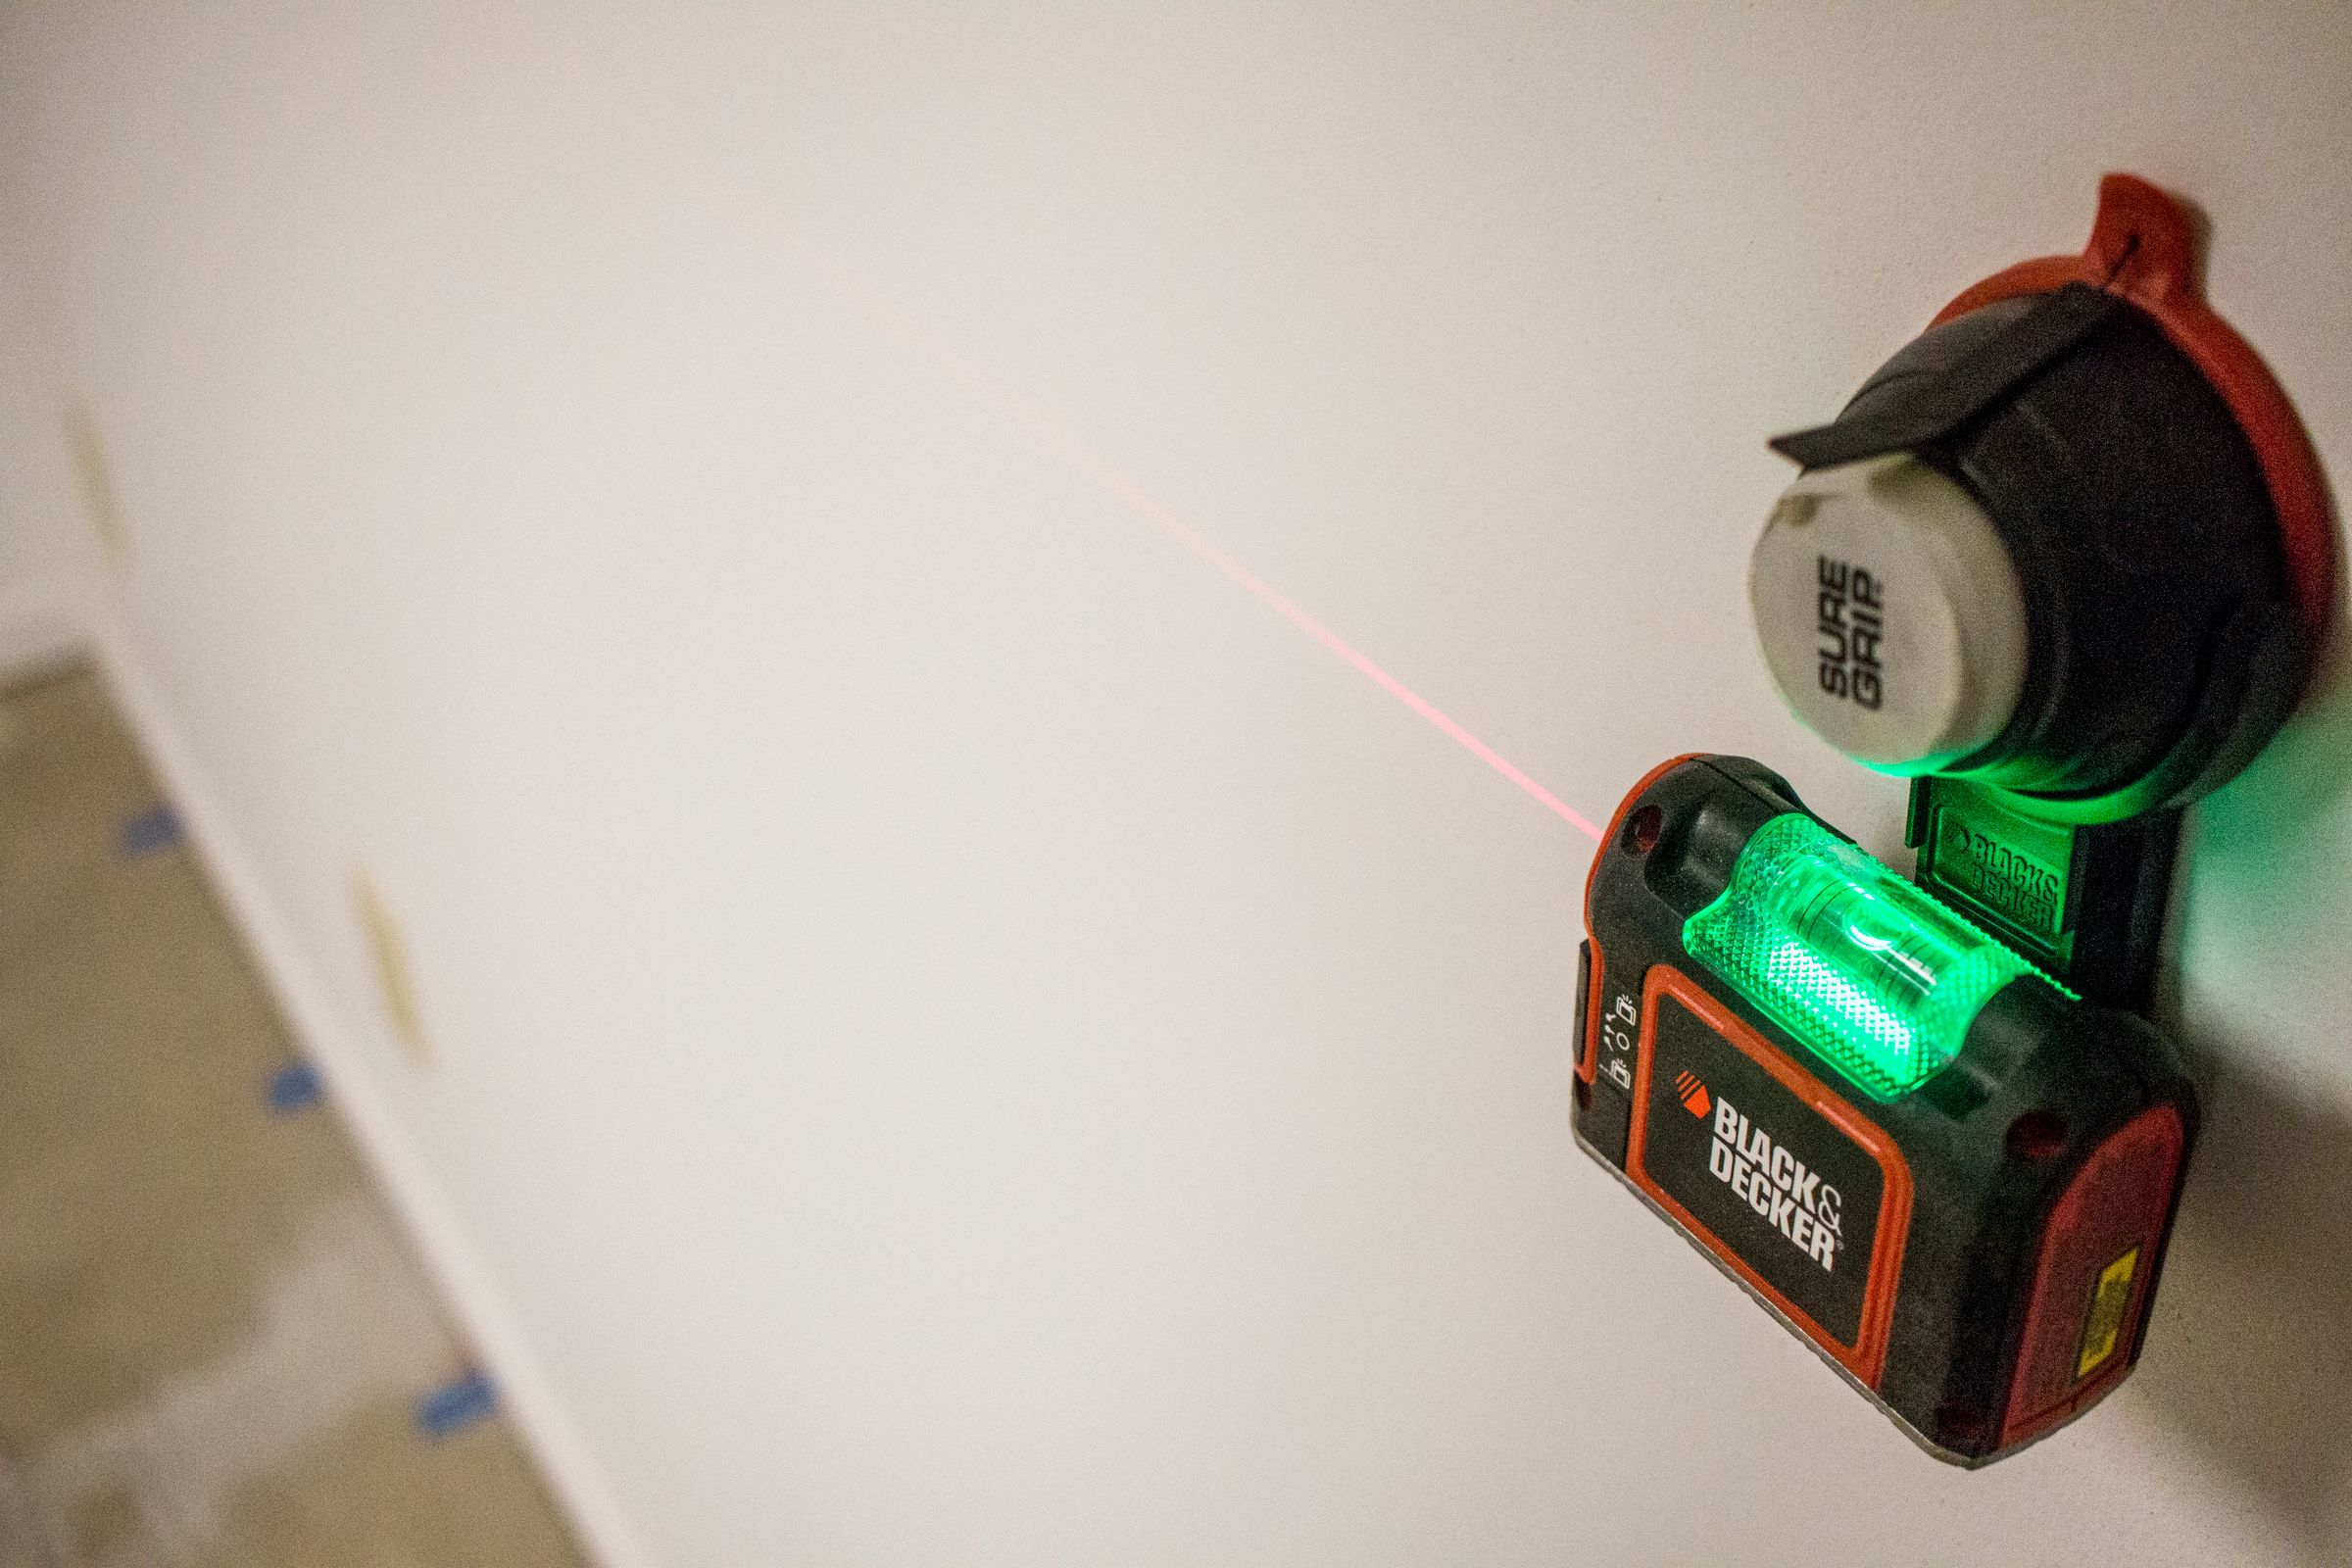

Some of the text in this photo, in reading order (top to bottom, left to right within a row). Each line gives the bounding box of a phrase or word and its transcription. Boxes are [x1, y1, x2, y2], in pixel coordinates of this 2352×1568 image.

[1818, 555, 1846, 699] SURE
[1851, 566, 1883, 710] GRIP
[1972, 861, 2055, 931] DECKER
[1709, 1136, 1836, 1272] DECKER
